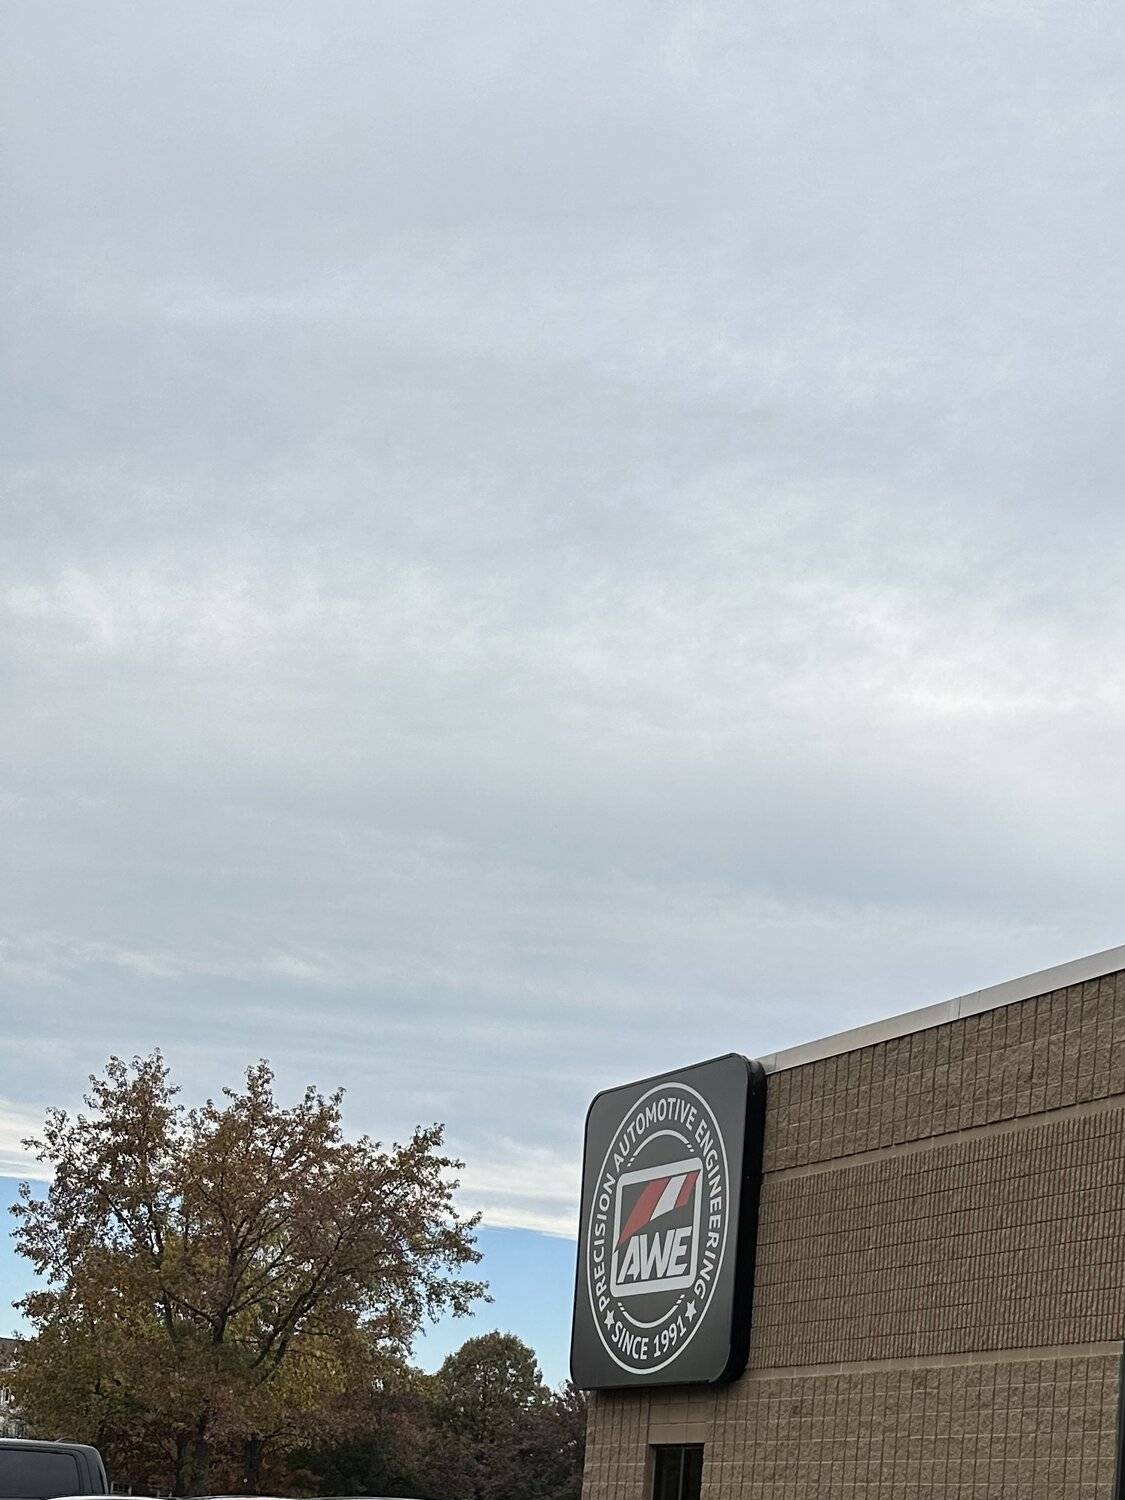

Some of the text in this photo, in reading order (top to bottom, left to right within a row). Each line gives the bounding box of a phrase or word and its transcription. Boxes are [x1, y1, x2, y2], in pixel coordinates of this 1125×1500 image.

[593, 1097, 722, 1312] PRECISION AUTOMOTIVE ENGINEERING
[616, 1225, 693, 1285] AWE
[612, 1315, 687, 1361] SINCE 1991
